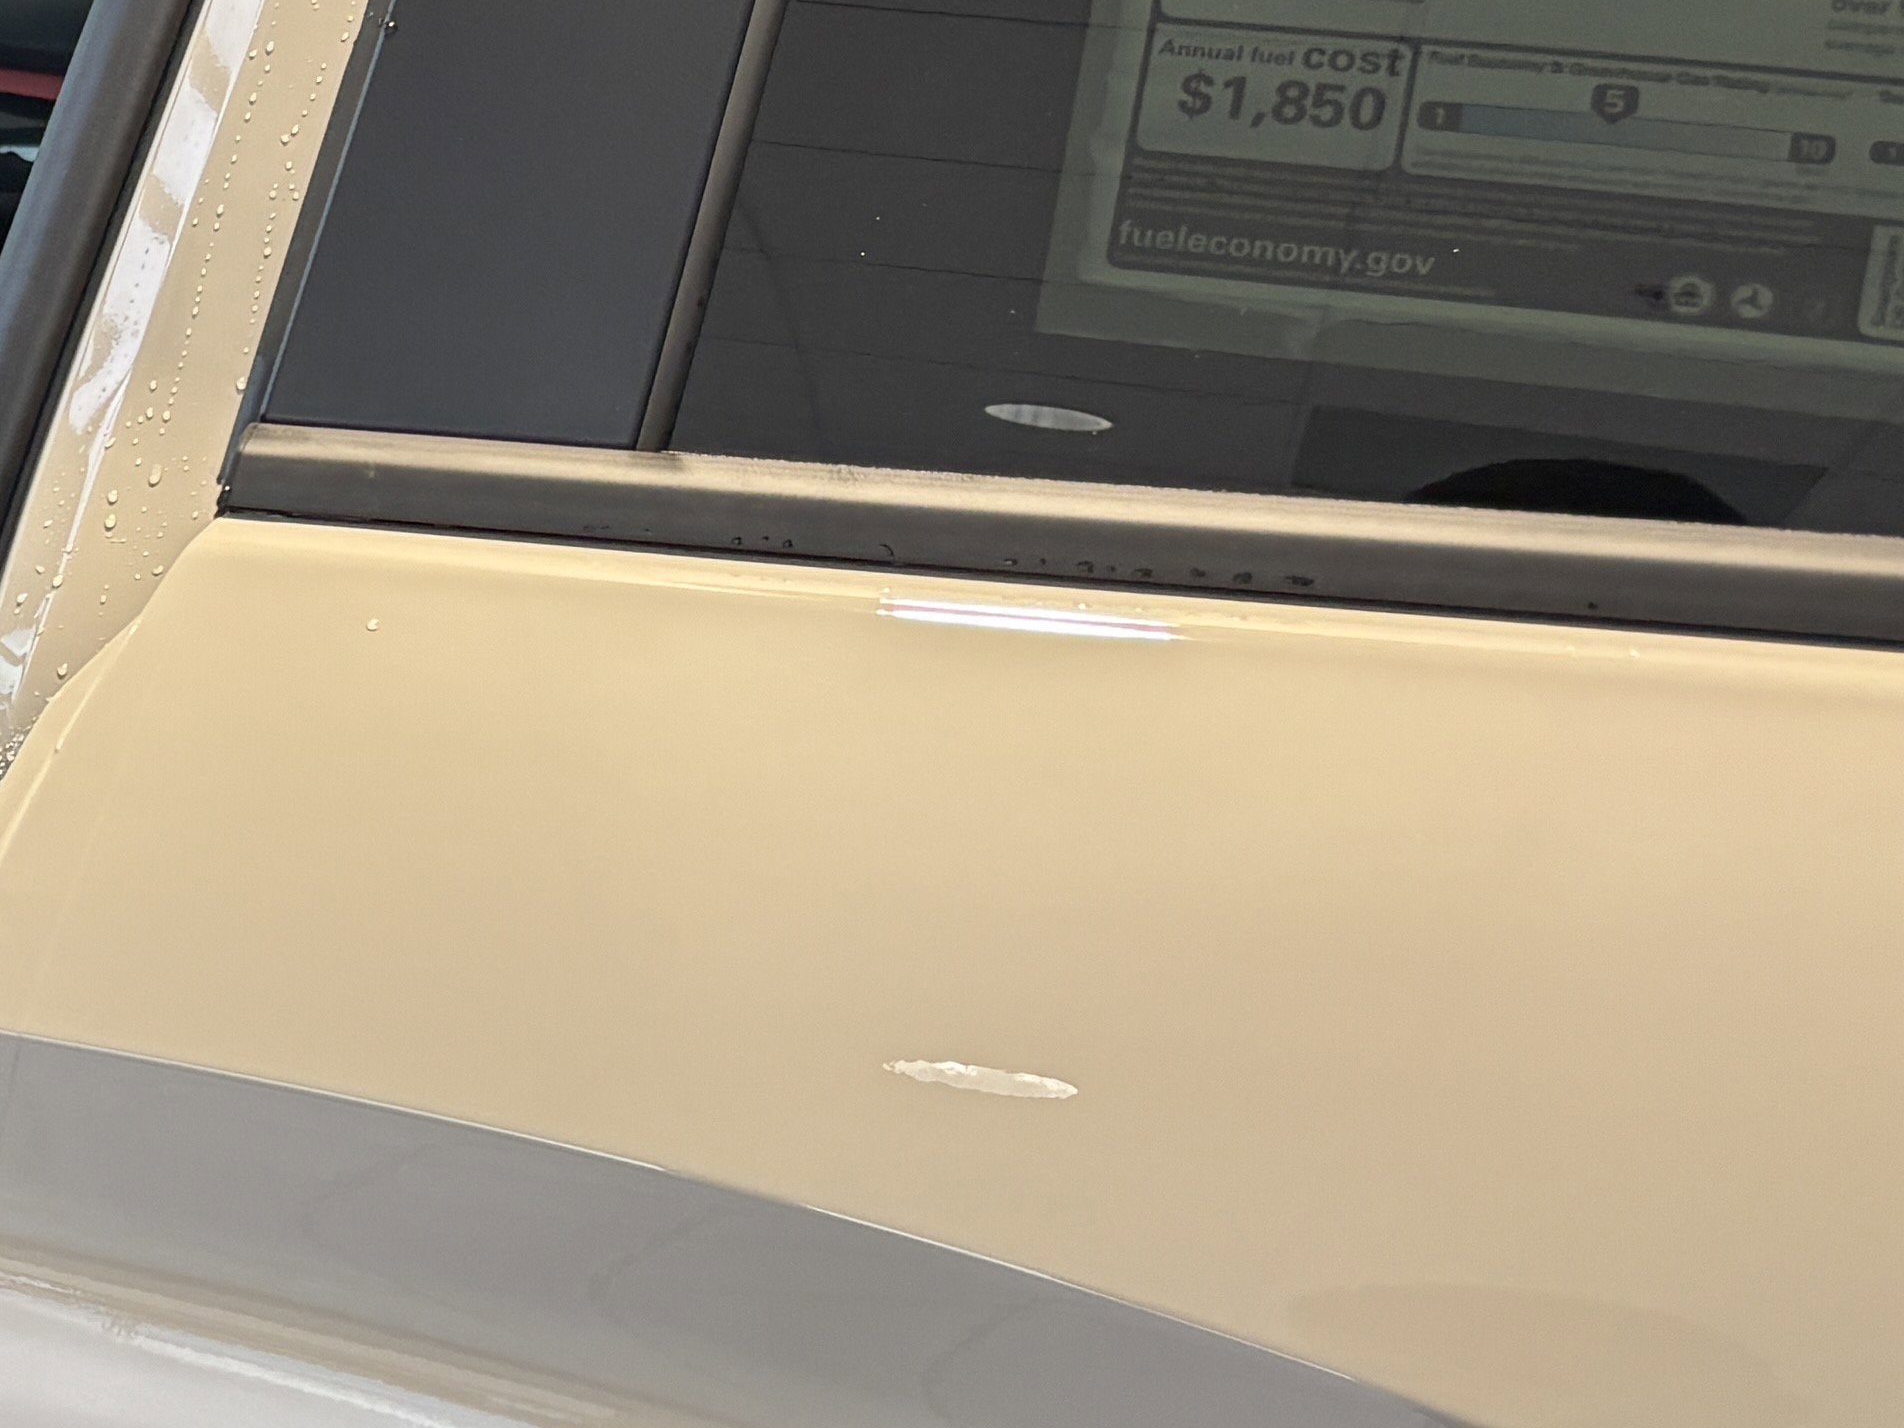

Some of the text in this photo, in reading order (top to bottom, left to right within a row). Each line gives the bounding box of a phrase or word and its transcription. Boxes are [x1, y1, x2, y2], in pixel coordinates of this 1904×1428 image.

[1158, 39, 1404, 77] Annual fuel cost
[1177, 69, 1386, 131] $1,850
[1603, 90, 1626, 112] 5
[1434, 108, 1445, 125] 1
[1799, 139, 1827, 157] 10
[1118, 220, 1436, 277] fueleconomy.gov
